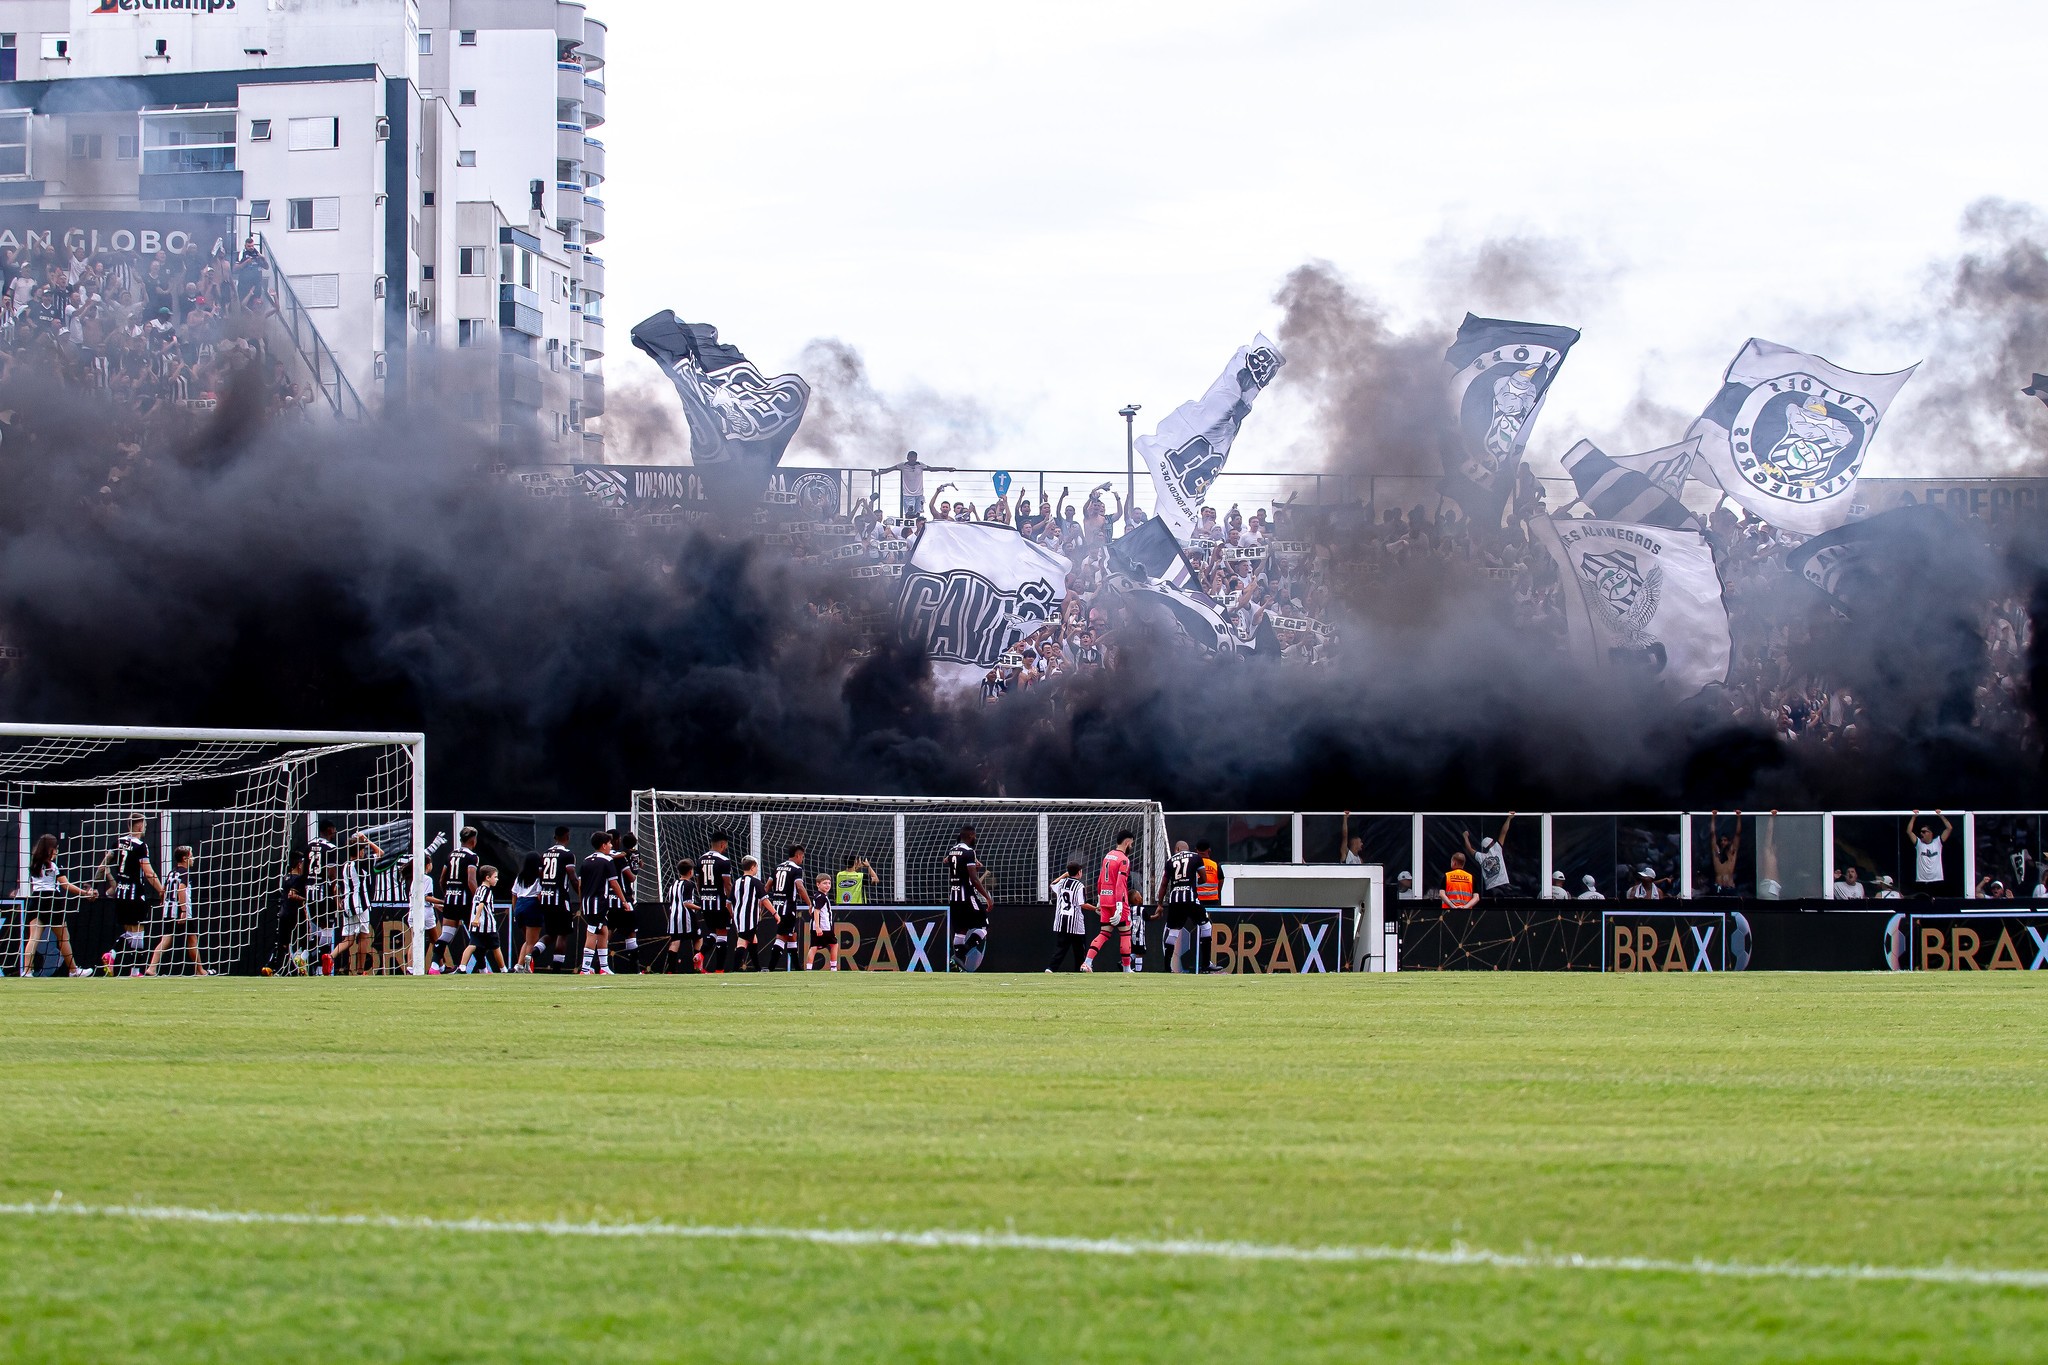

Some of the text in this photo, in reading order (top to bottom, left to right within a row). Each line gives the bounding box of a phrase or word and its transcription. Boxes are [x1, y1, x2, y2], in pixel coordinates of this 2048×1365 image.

[64, 229, 188, 254] GLOBO
[880, 541, 907, 551] FGP
[1283, 542, 1311, 552] FGP
[1582, 525, 1662, 555] ALVINEGROS
[1236, 548, 1266, 557] FGP
[1602, 572, 1624, 592] FFC
[901, 573, 1054, 663] GAVIÕ
[1276, 618, 1307, 629] FGP
[308, 851, 322, 874] 23
[450, 857, 461, 879] 11
[543, 857, 558, 879] 20
[1104, 861, 1110, 882] 1
[1172, 857, 1189, 880] 27
[702, 864, 715, 886] 14
[775, 870, 787, 892] 10
[1211, 922, 1329, 974] BRAX
[1614, 925, 1715, 972] BRAX
[1921, 926, 2048, 971] BRAX
